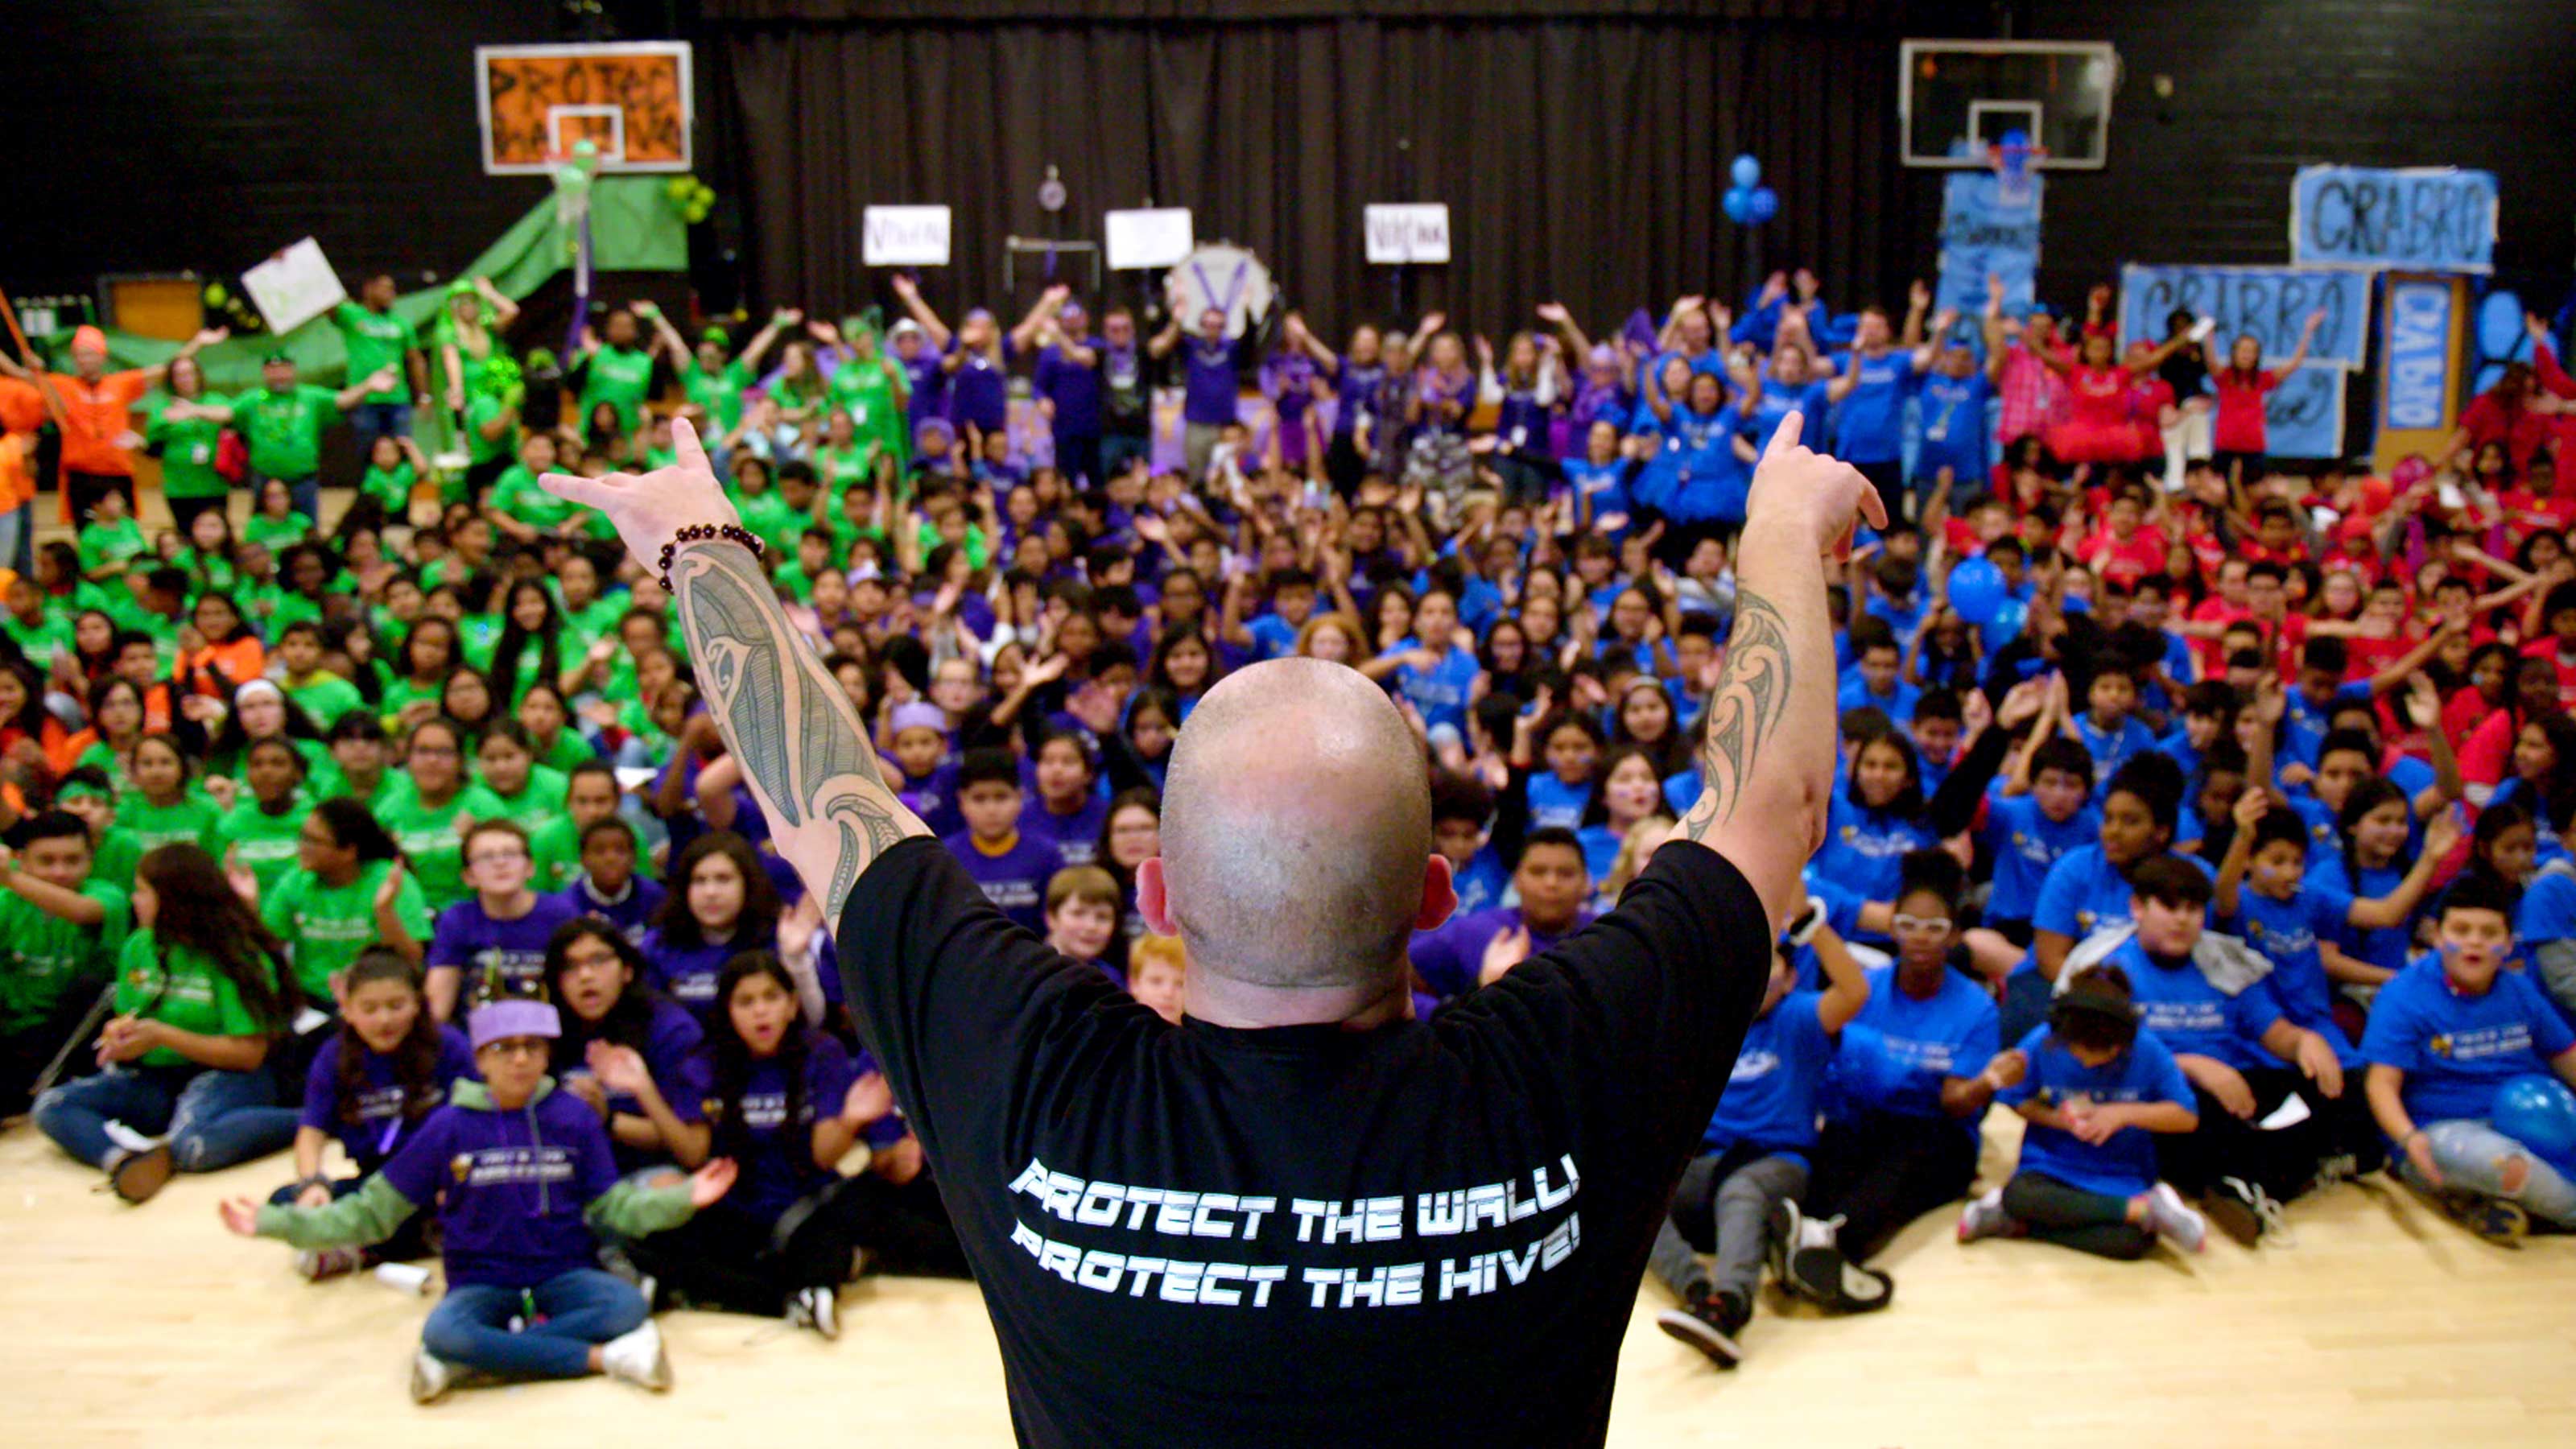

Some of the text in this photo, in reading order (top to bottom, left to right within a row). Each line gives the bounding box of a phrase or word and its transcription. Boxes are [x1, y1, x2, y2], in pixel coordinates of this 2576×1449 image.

[2310, 179, 2483, 260] CRABRO
[1009, 1153, 1581, 1245] PROTECT THE WALL!
[1009, 1211, 1582, 1308] PROTECT THE HIVE!
